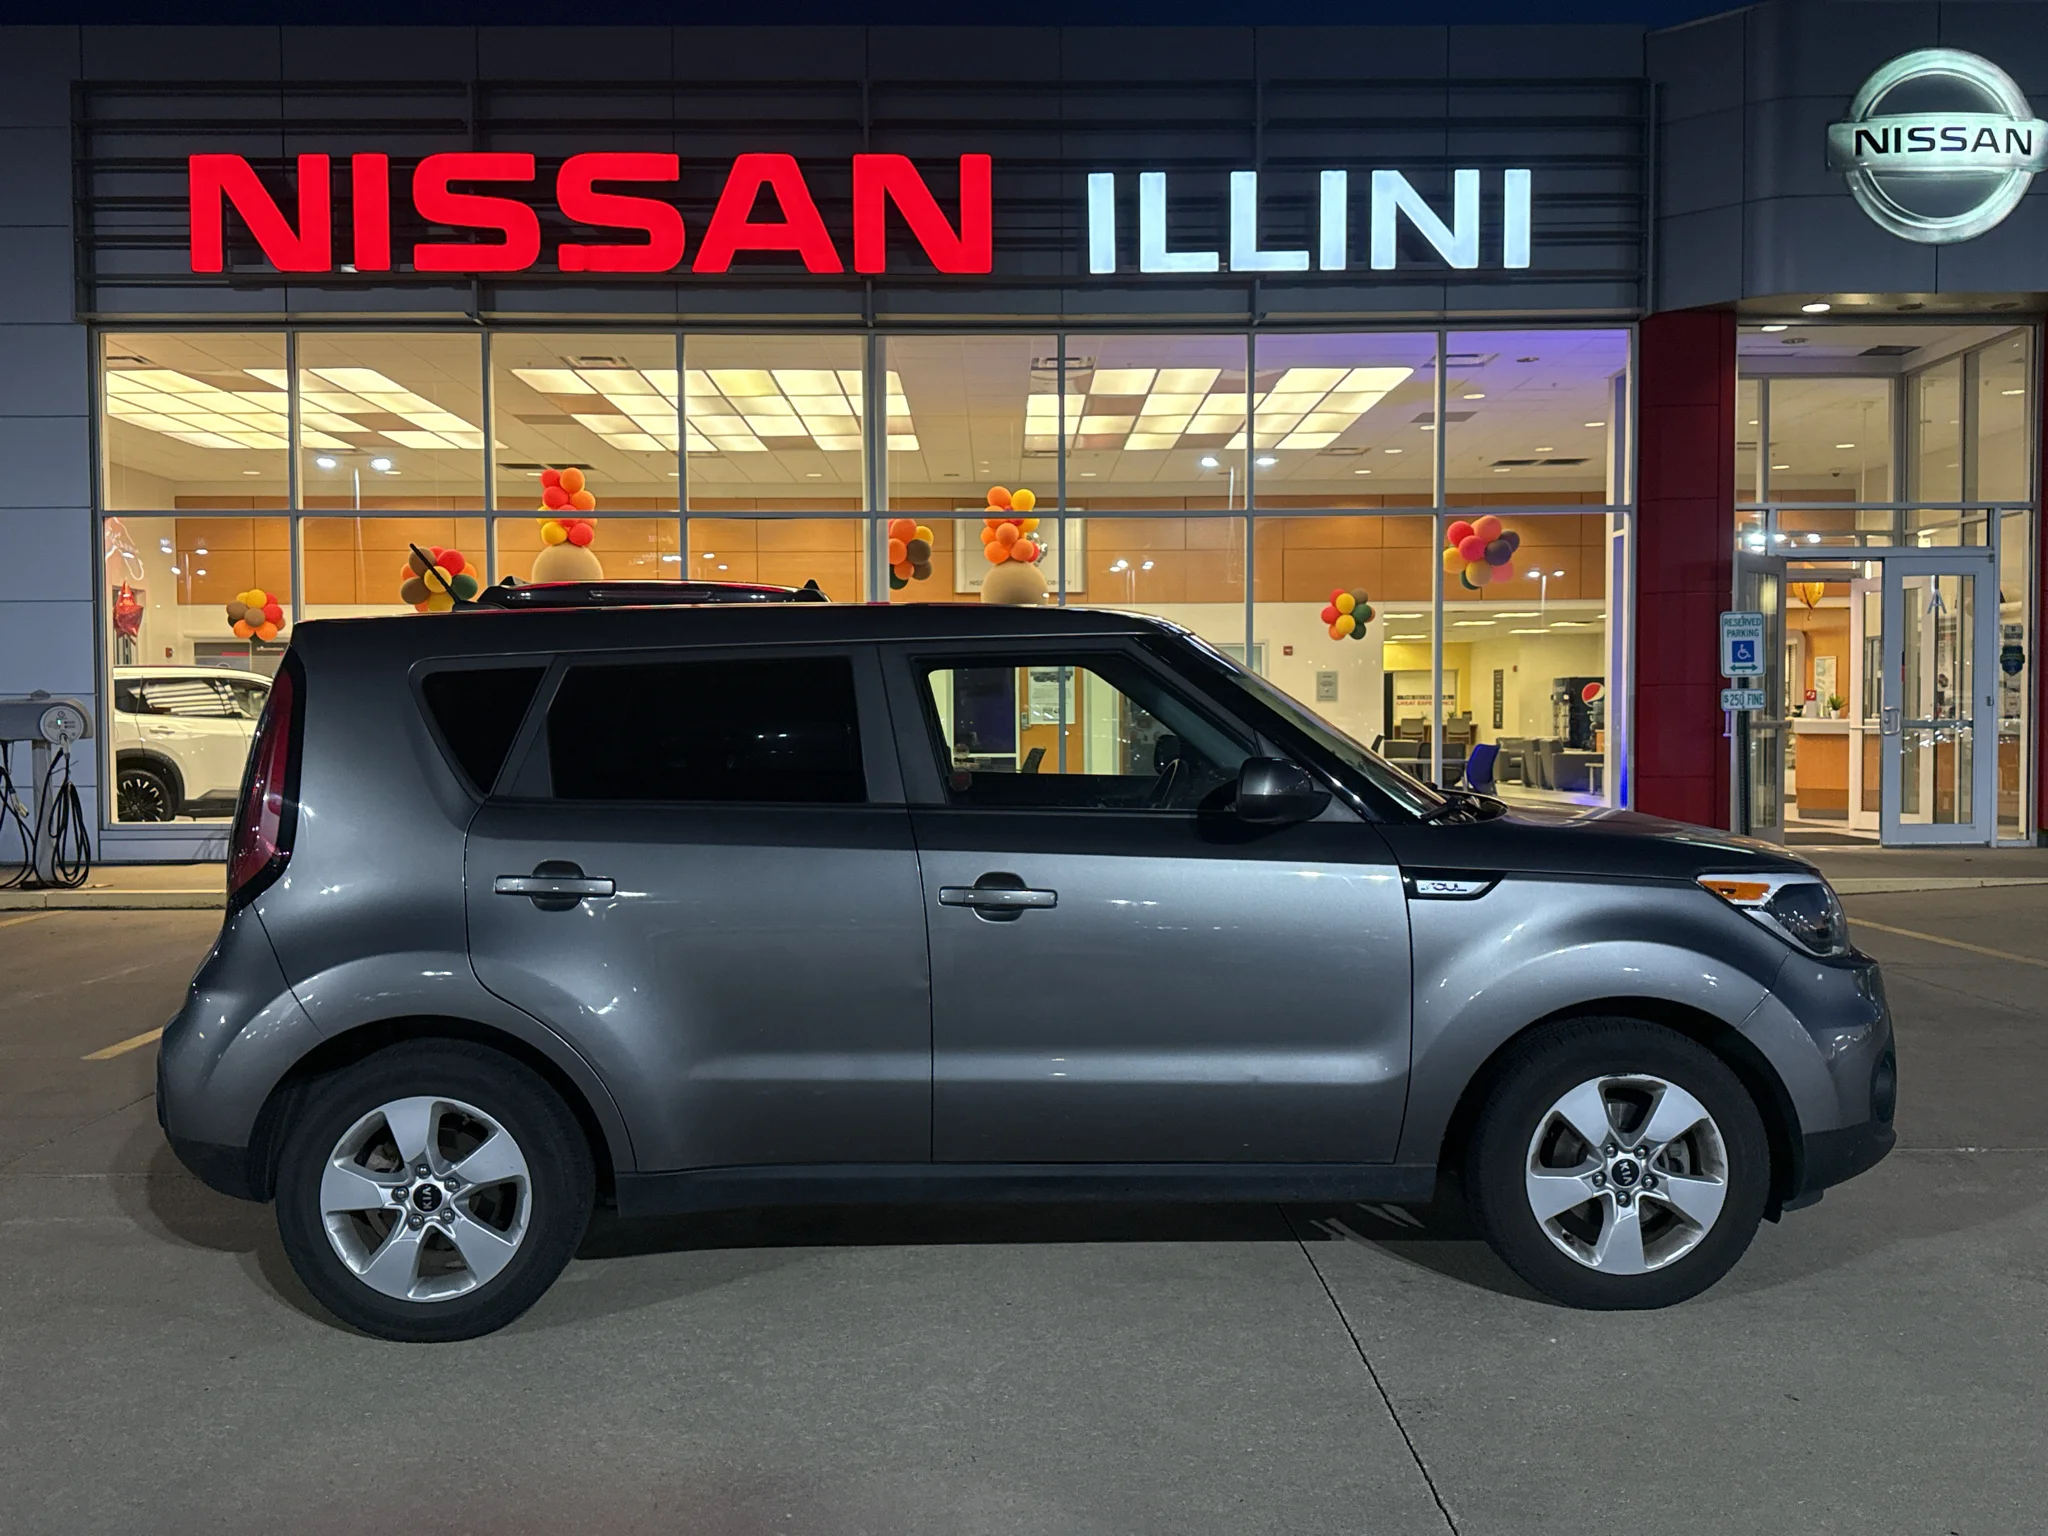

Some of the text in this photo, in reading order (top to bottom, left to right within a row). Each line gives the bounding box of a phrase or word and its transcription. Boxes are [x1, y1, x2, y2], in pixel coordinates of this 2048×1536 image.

[1855, 127, 2032, 156] NISSAN
[188, 153, 1531, 274] NISSAN ILLINI
[1723, 617, 1762, 627] RESERVED
[1726, 627, 1759, 638] PARKING
[1723, 693, 1764, 706] $250 FINE
[1619, 1161, 1633, 1185] KIA
[422, 1186, 433, 1210] KIA
